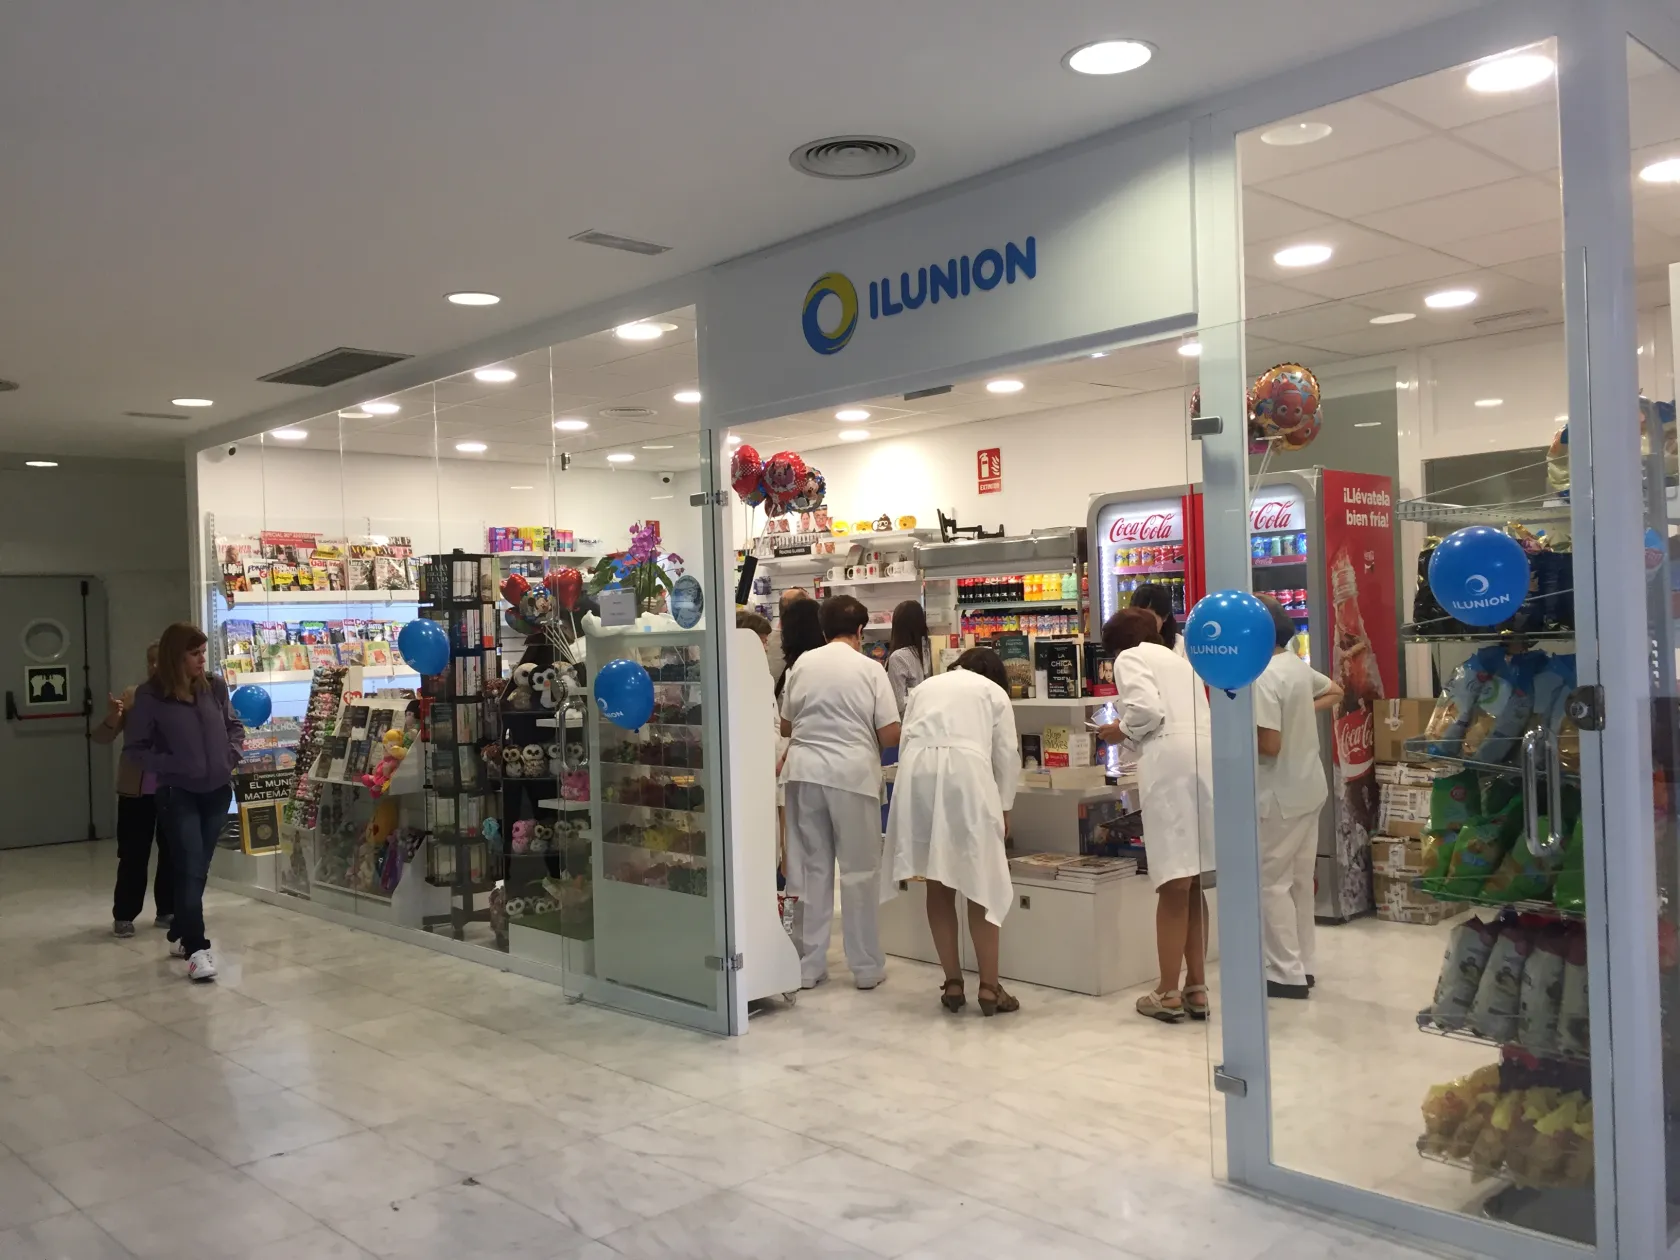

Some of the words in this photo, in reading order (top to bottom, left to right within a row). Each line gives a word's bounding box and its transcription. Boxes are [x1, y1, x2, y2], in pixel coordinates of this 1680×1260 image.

[869, 236, 1037, 320] ILUNION
[1343, 487, 1390, 506] ¡Llévatela
[1346, 509, 1368, 526] bien
[1370, 511, 1389, 528] fría!
[1452, 593, 1510, 609] ILUNION
[1190, 644, 1238, 655] ILUNION
[1051, 660, 1073, 668] CHICA
[249, 780, 263, 790] EL
